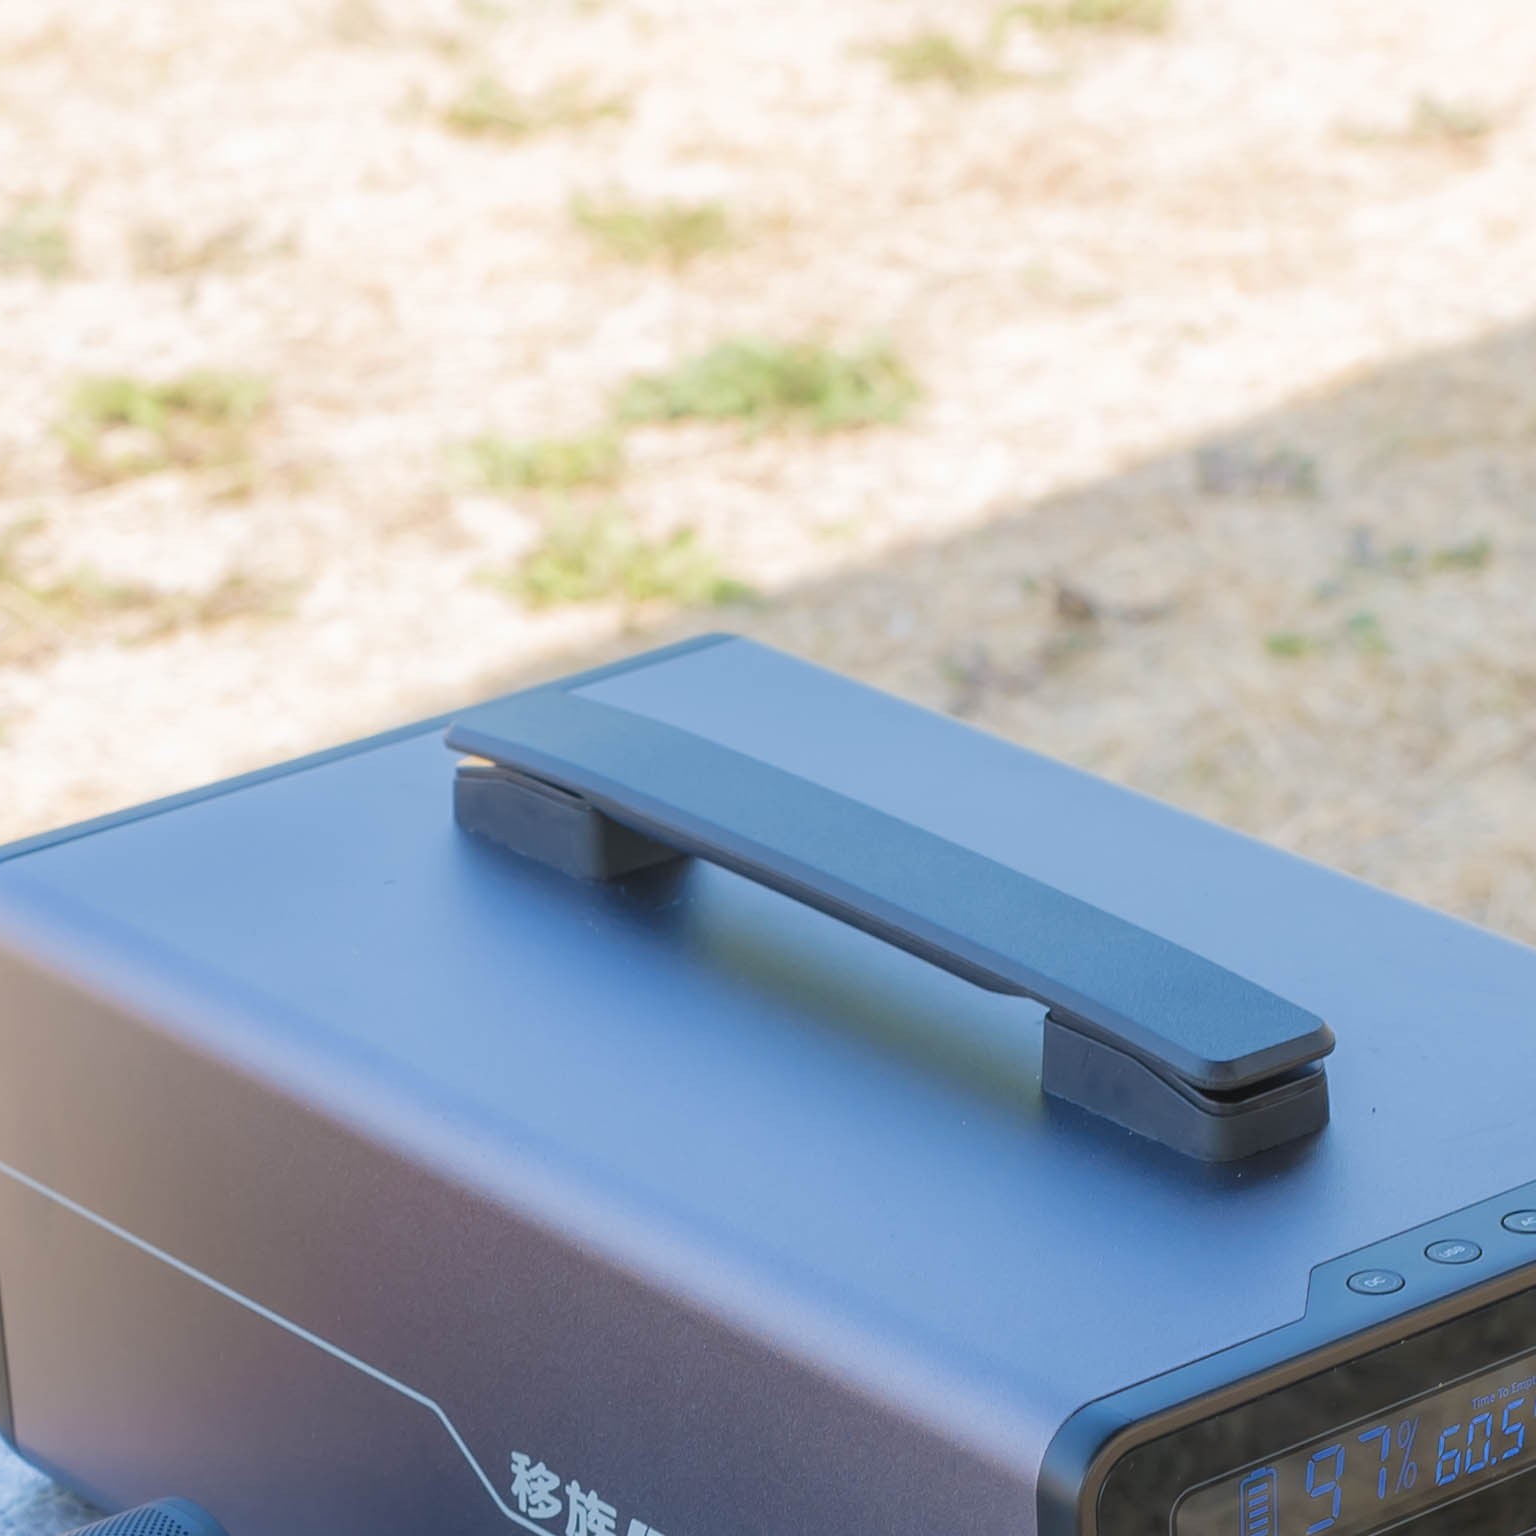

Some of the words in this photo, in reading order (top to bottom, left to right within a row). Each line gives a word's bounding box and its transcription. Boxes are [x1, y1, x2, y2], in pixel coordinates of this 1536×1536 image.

[1363, 1275, 1386, 1288] DC
[1471, 1393, 1495, 1410] Time
[1497, 1385, 1509, 1399] To
